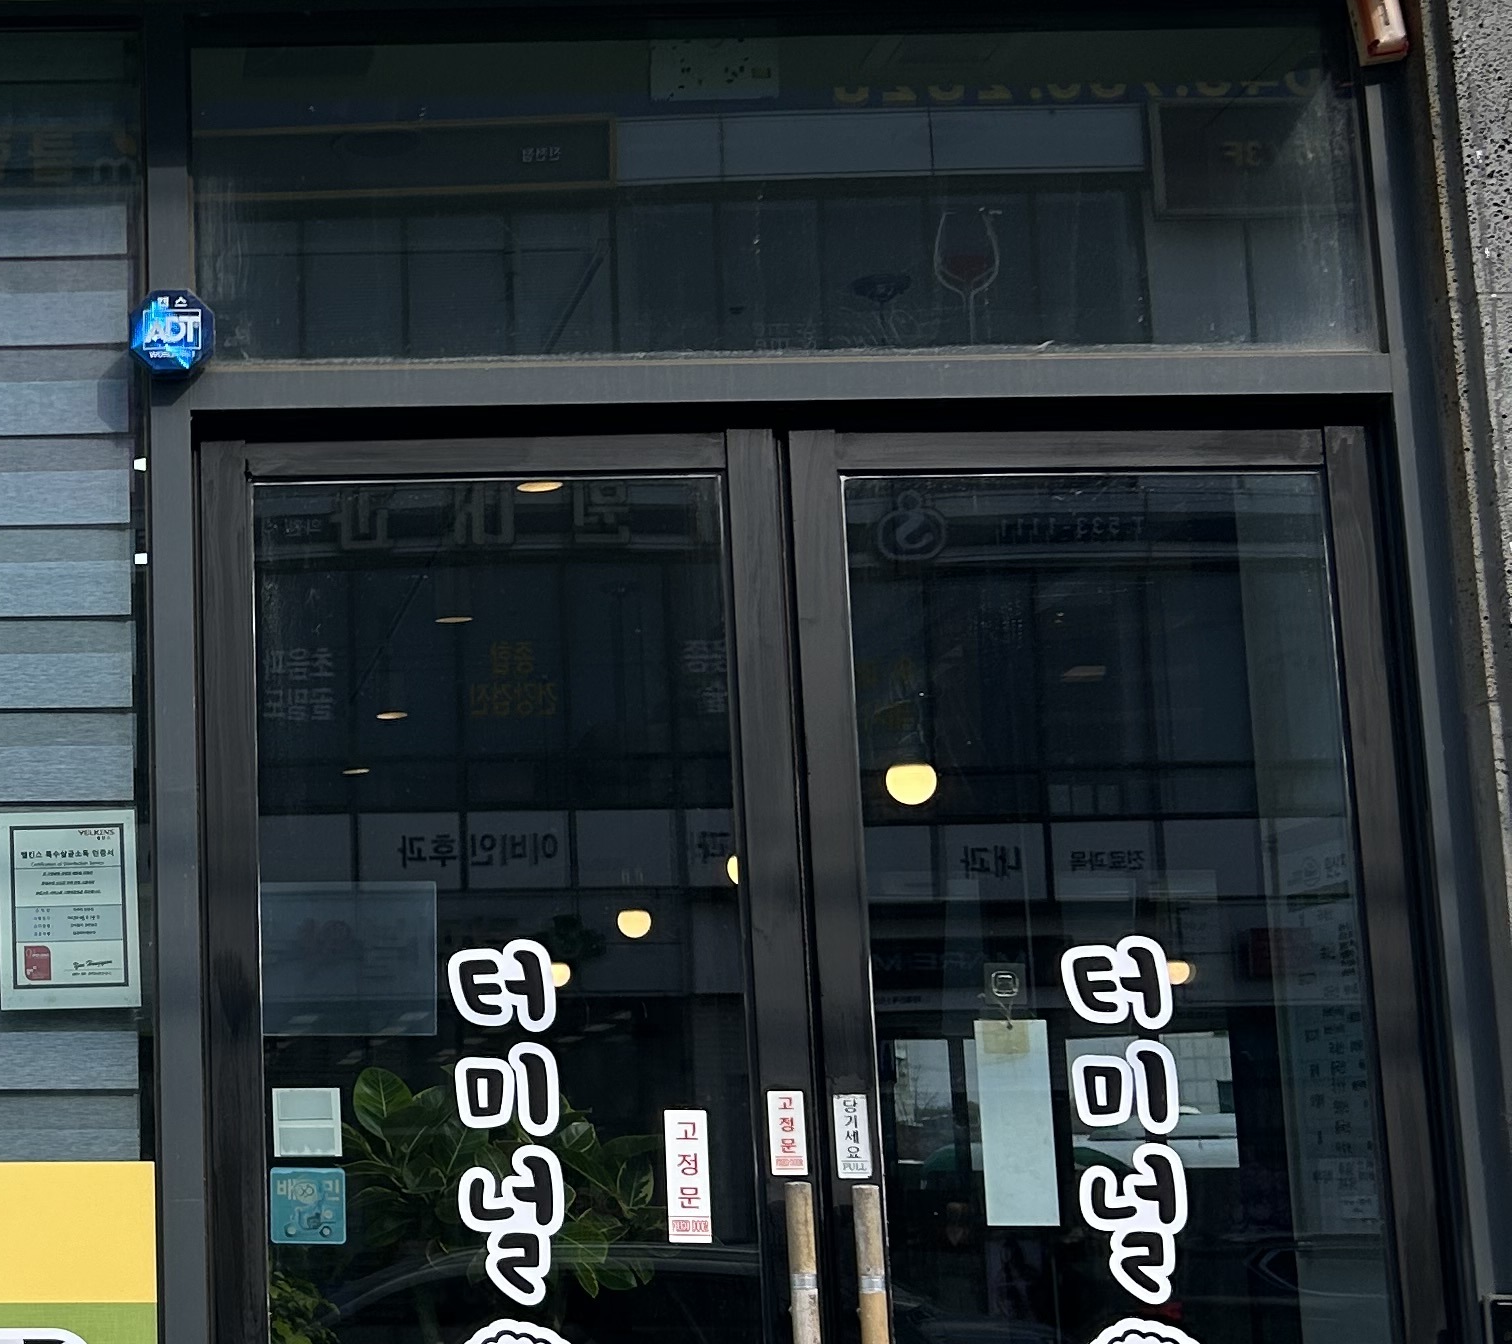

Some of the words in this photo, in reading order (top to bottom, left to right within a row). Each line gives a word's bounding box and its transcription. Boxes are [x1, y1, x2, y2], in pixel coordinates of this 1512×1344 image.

[144, 315, 199, 343] ADT
[458, 947, 556, 1297] 터미널
[777, 1096, 796, 1153] 고정문
[843, 1098, 862, 1159] 당기세요
[1073, 944, 1183, 1296] 터미널
[675, 1121, 701, 1209] 고정문
[843, 1162, 867, 1171] PULL
